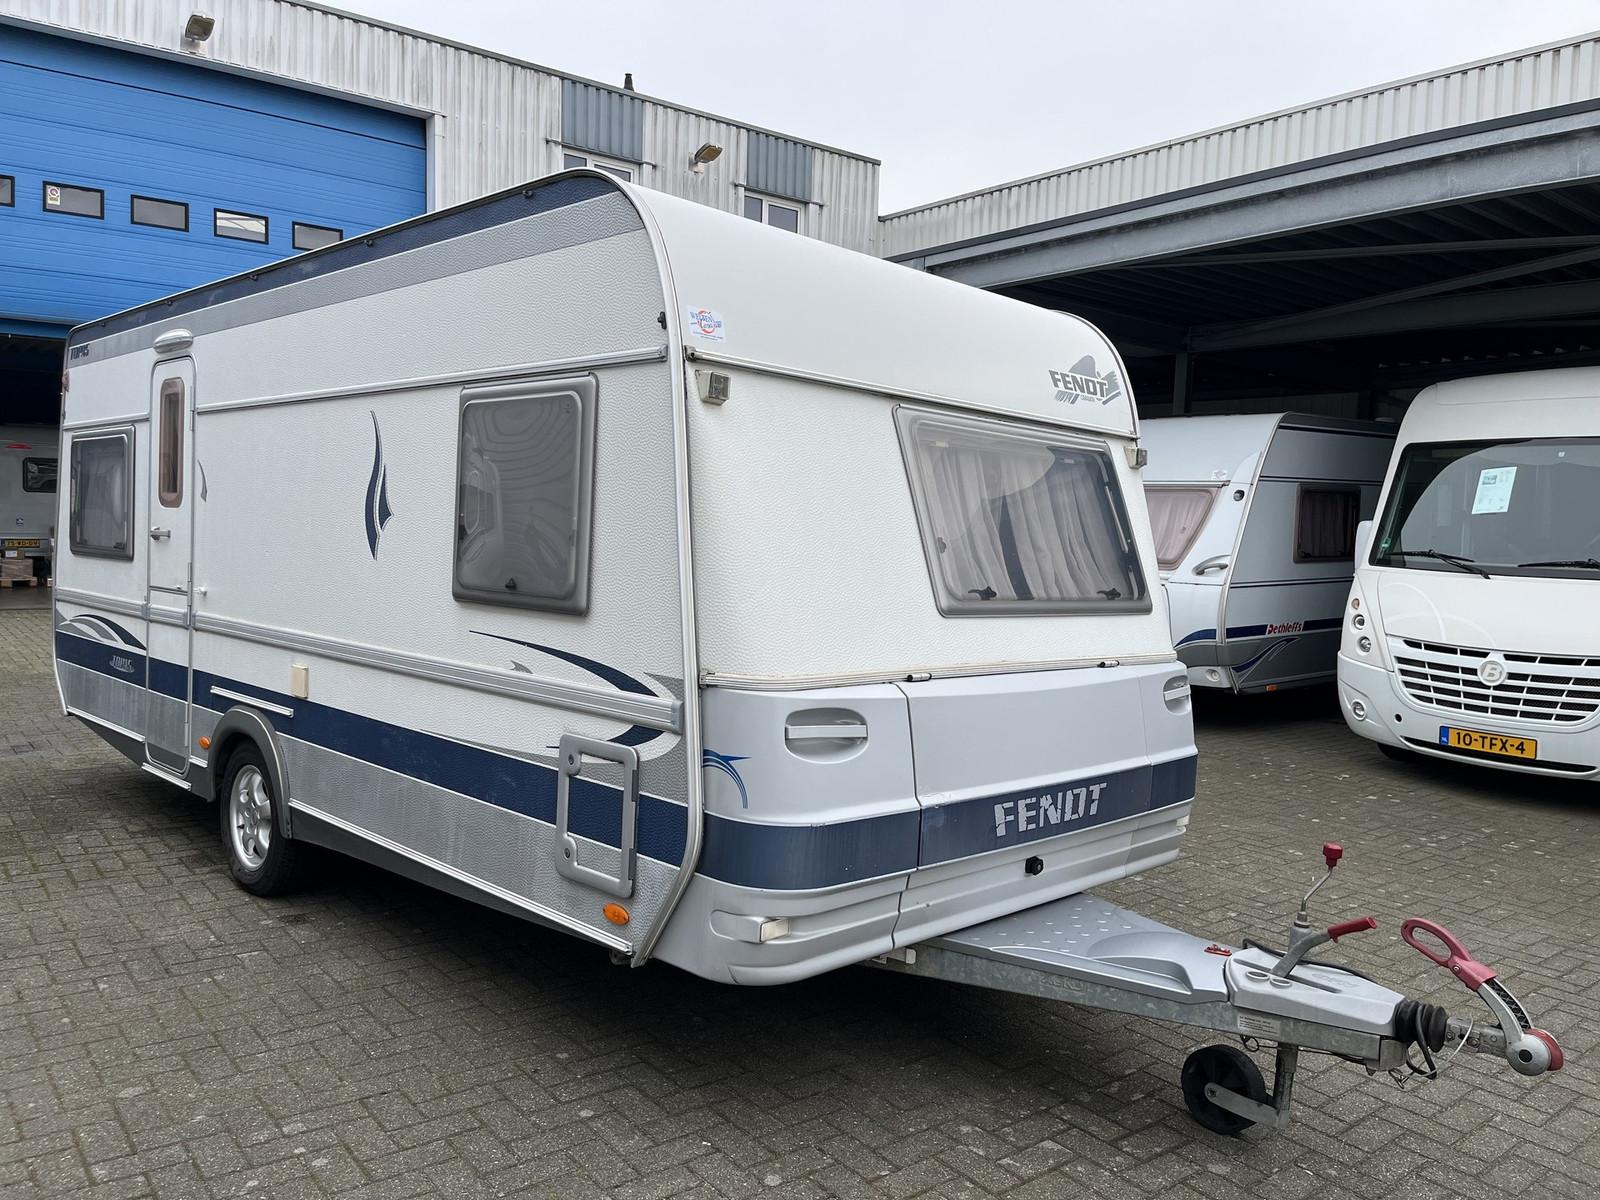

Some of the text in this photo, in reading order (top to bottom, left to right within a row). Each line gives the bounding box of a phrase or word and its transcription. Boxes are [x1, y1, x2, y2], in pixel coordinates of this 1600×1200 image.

[1048, 369, 1107, 398] FENDT
[1267, 622, 1302, 634] Dethleffs
[1456, 731, 1526, 754] 10-TFX-4
[994, 782, 1107, 837] FENDT
